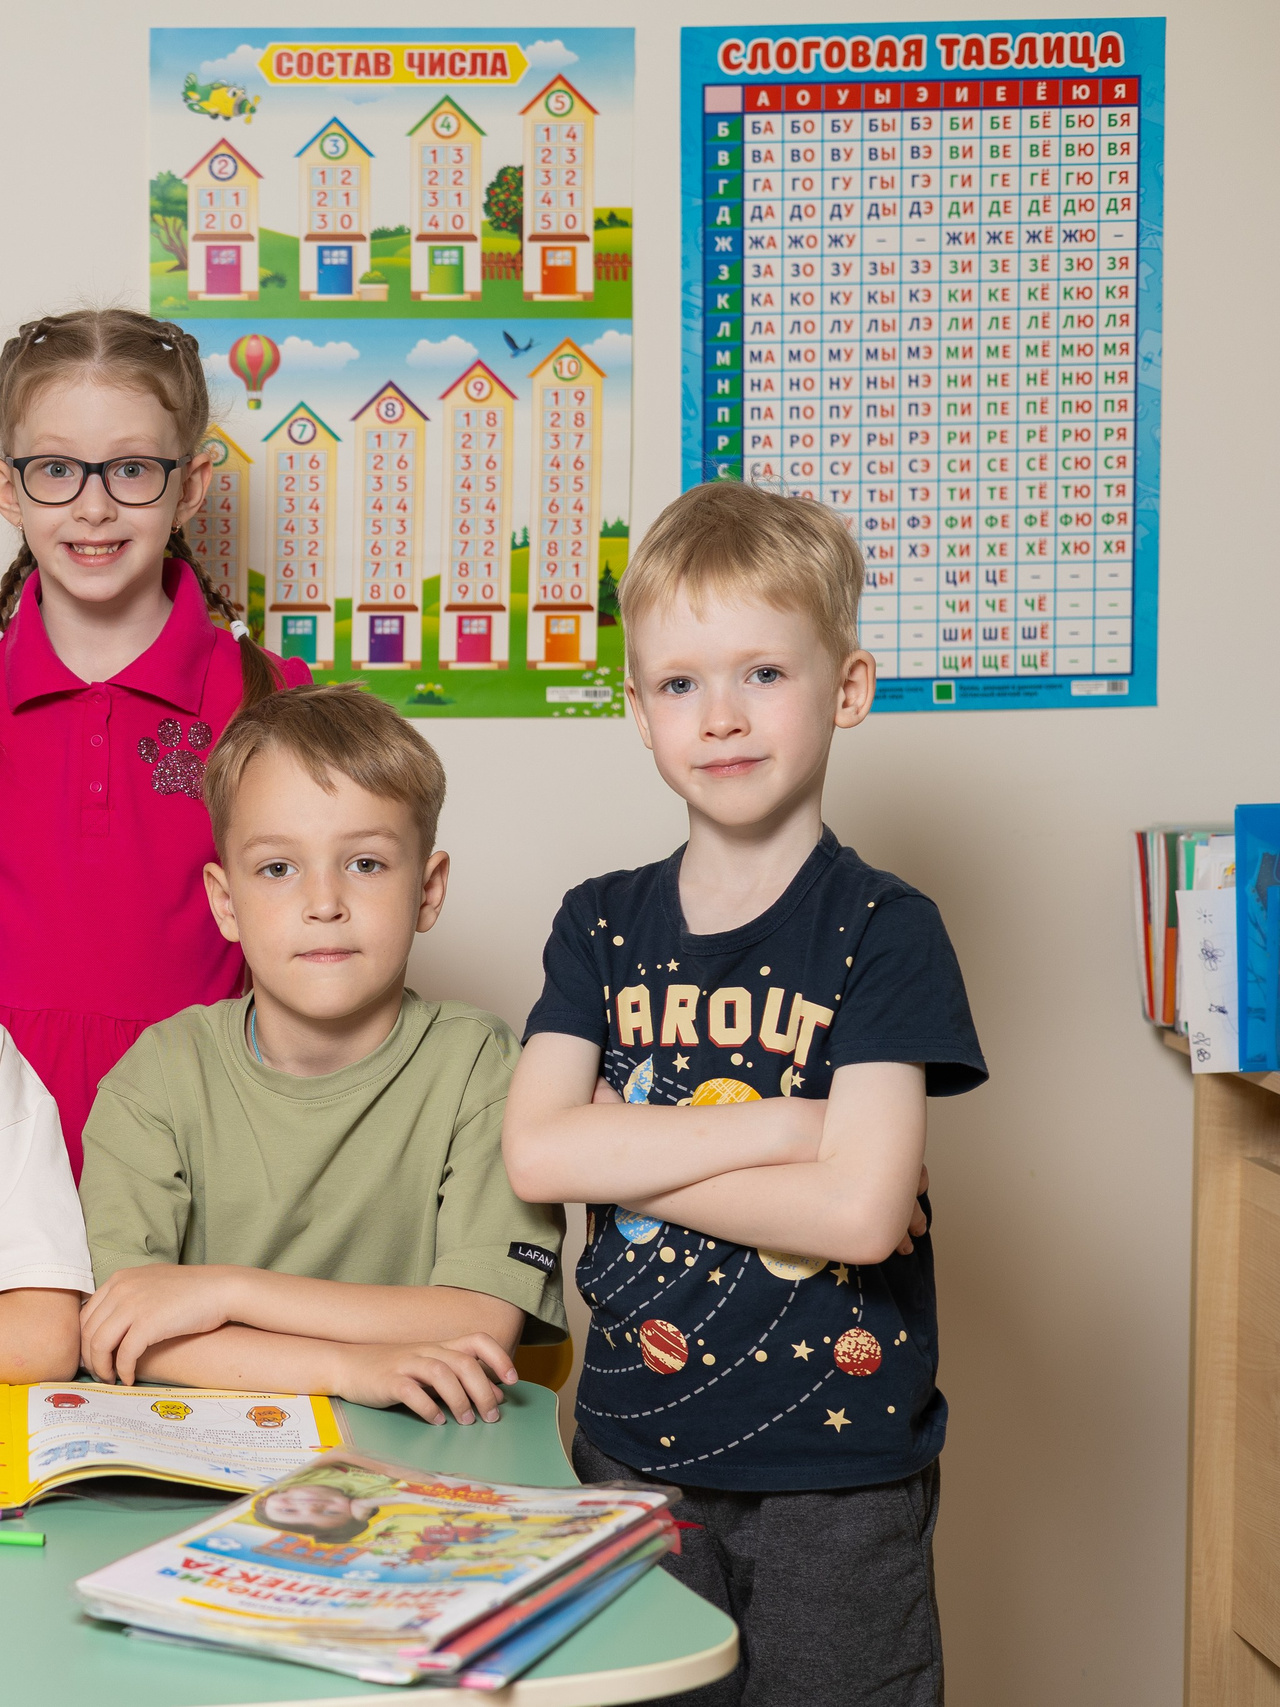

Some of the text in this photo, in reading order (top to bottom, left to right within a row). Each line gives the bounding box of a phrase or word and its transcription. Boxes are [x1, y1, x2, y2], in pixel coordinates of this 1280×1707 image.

[721, 34, 1122, 70] СЛОГОВАЯ ТАБЛИЦА
[275, 52, 509, 77] СОСТАВ ЧИСЛА
[756, 81, 1126, 107] А О У Ы Э И Е Ё Ю Я
[554, 95, 565, 111] 5
[440, 117, 452, 132] 4
[717, 112, 1130, 138] Б БА БО БУ БЫ БЭ БИ БЕ БЁ БЮ БЯ
[542, 126, 577, 141] 1 4
[330, 139, 340, 155] 3
[429, 147, 464, 165] 1 3
[541, 147, 577, 165] 2 3
[717, 150, 730, 166] В
[218, 159, 229, 175] 2
[318, 169, 351, 186] 1 2
[428, 168, 464, 187] 2 2
[541, 168, 577, 187] 3 2
[718, 179, 729, 195] Г
[206, 191, 240, 206] 1 1
[317, 190, 351, 208] 2 1
[429, 190, 462, 207] 3 1
[541, 191, 575, 207] 4 1
[205, 213, 243, 230] 2 0
[318, 213, 353, 230] 3 0
[427, 213, 465, 231] 4 0
[541, 213, 577, 230] 5 0
[716, 205, 731, 225] Д
[714, 227, 1094, 252] Ж ЖА ЖО ЖУ ЖИ ЖЕ ЖЁ ЖЮ
[718, 264, 730, 281] З
[717, 293, 730, 309] К
[717, 321, 731, 338] Л
[716, 341, 1129, 366] М МА МО МУ МЫ МЭ МИ МЕ МЁ МЮ МЯ
[556, 360, 579, 376] 10
[473, 381, 484, 396] 9
[717, 378, 730, 395] Н
[384, 402, 396, 418] 8
[717, 407, 730, 423] П
[297, 424, 308, 439] 7
[717, 435, 730, 451] Р
[866, 540, 1125, 559] ХЫ ХЭ ХИ ХЕ ХЁ ХЮ ХЯ
[866, 569, 1007, 588] ЦЫ ЦИ ЦЕ
[946, 596, 1046, 613] ЧИ ЧЕ ЧЁ
[943, 624, 1048, 641] ШИ ШЕ ШЁ
[943, 652, 1048, 672] ЩИ ЩЕ ЩЁ
[604, 984, 834, 1068] AROUT
[518, 1246, 556, 1268] LAFAM
